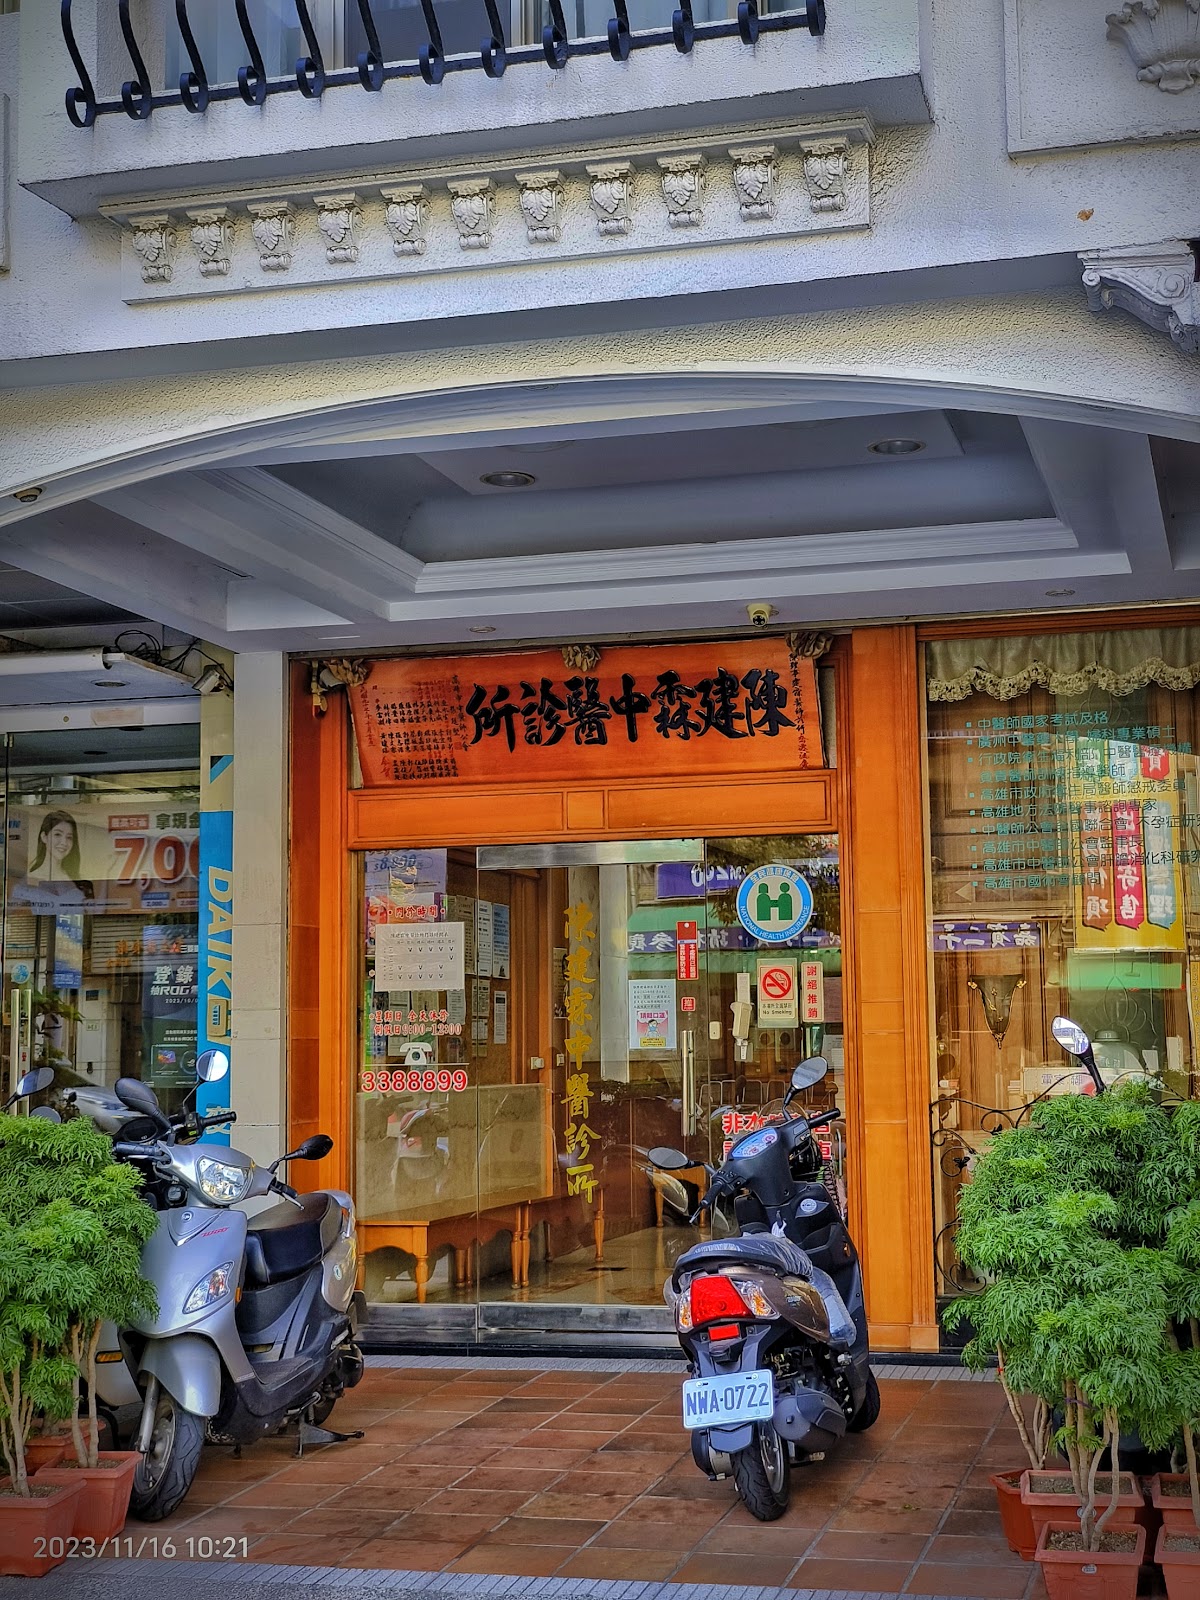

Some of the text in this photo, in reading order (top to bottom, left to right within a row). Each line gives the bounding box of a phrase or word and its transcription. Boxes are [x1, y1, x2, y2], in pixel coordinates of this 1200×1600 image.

[471, 667, 796, 752] 陳建霖中醫診所
[978, 711, 1108, 730] 中醫師國家考試及格
[1138, 813, 1200, 829] 不孕症研
[395, 905, 438, 919] 門診時間
[740, 905, 760, 935] NATIONAL
[759, 930, 784, 939] HEALTH
[785, 905, 810, 937] INSURANCE
[207, 866, 233, 1046] DAIK
[153, 965, 194, 984] 登錄
[807, 966, 818, 1018] 謝絕推銷
[375, 1009, 449, 1022] 星期日 全天休診
[561, 903, 601, 1204] 陳建霖中醫診所
[361, 1070, 467, 1092] 3388899
[686, 1382, 770, 1417] NWA-0722
